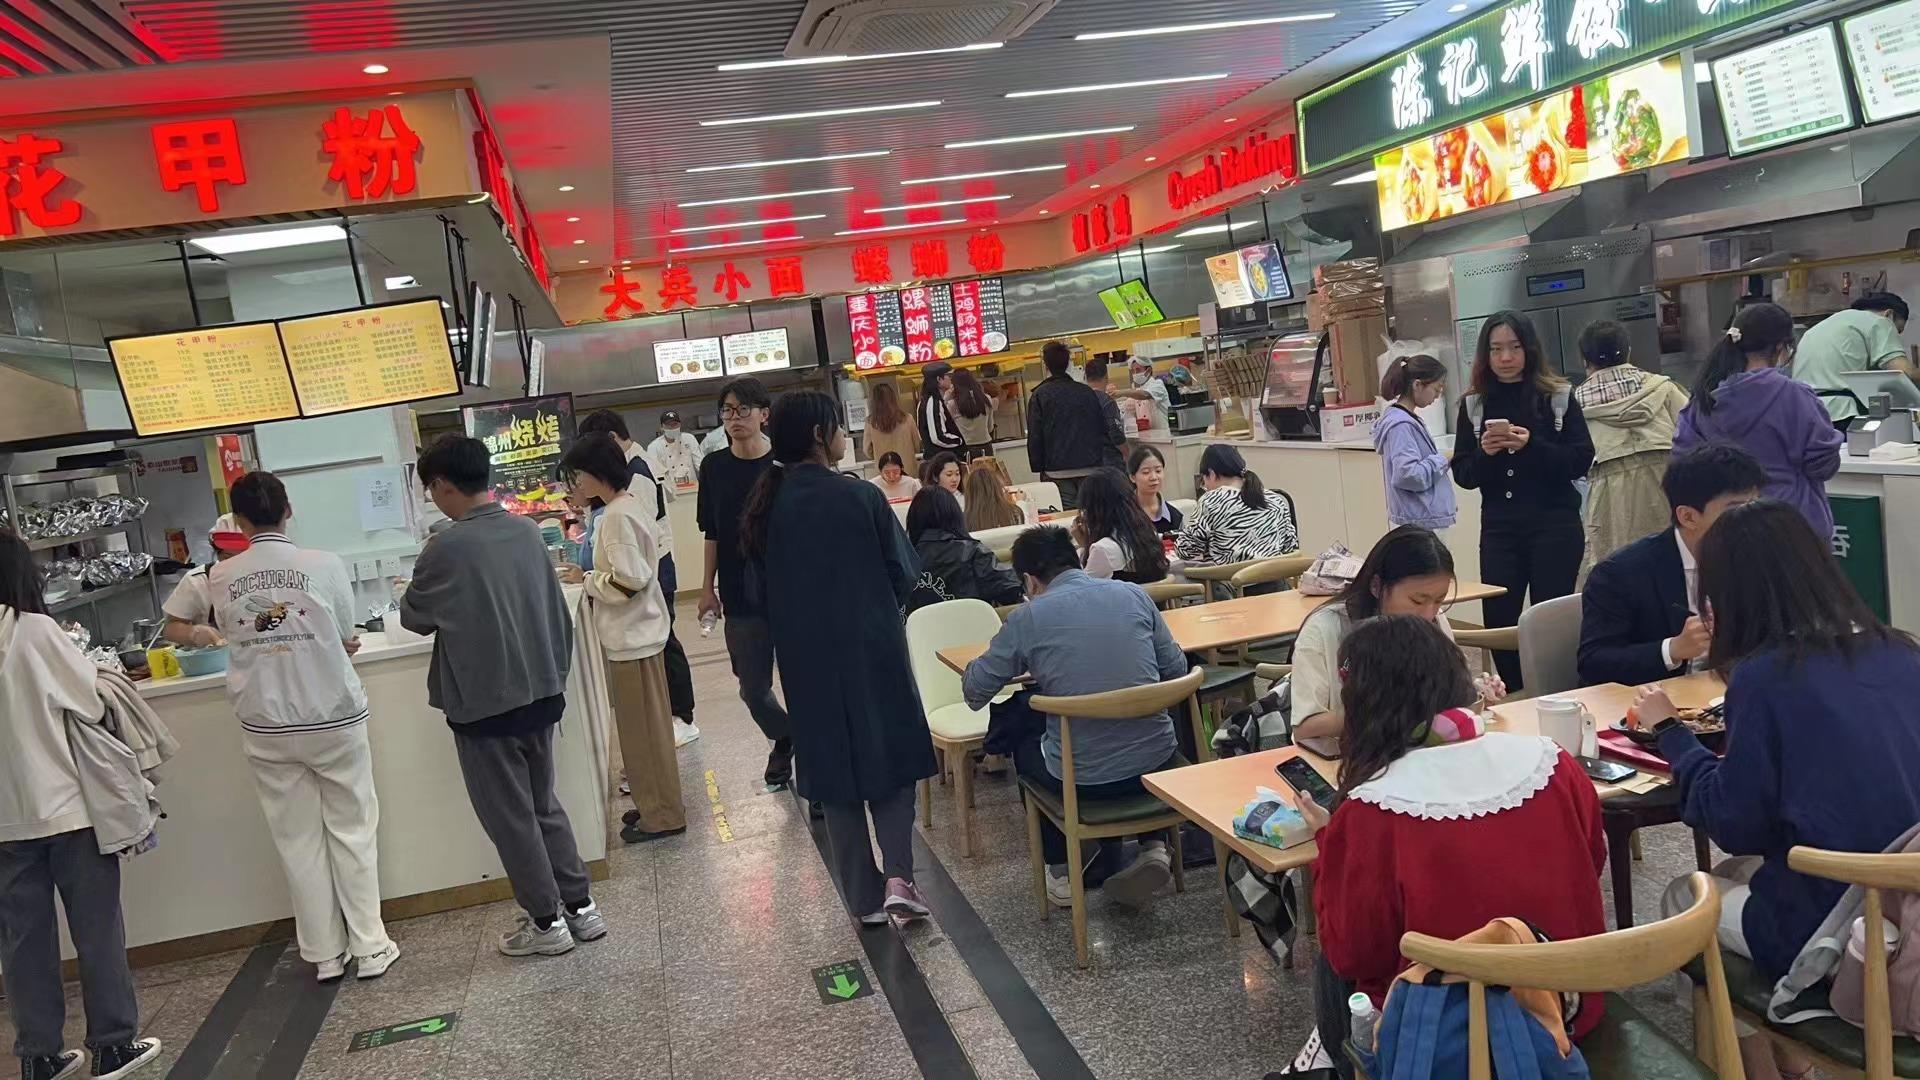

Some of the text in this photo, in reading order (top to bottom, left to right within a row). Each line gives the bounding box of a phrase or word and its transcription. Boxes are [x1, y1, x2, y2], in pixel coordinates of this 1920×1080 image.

[0, 104, 421, 236] 花甲粉
[1221, 132, 1298, 188] Baking
[601, 255, 806, 318] 大兵小面
[176, 335, 217, 347] 花甲粉
[849, 295, 876, 367] 重庆小面
[902, 288, 932, 362] 螺蛳粉
[229, 569, 310, 602] MICHIGAN
